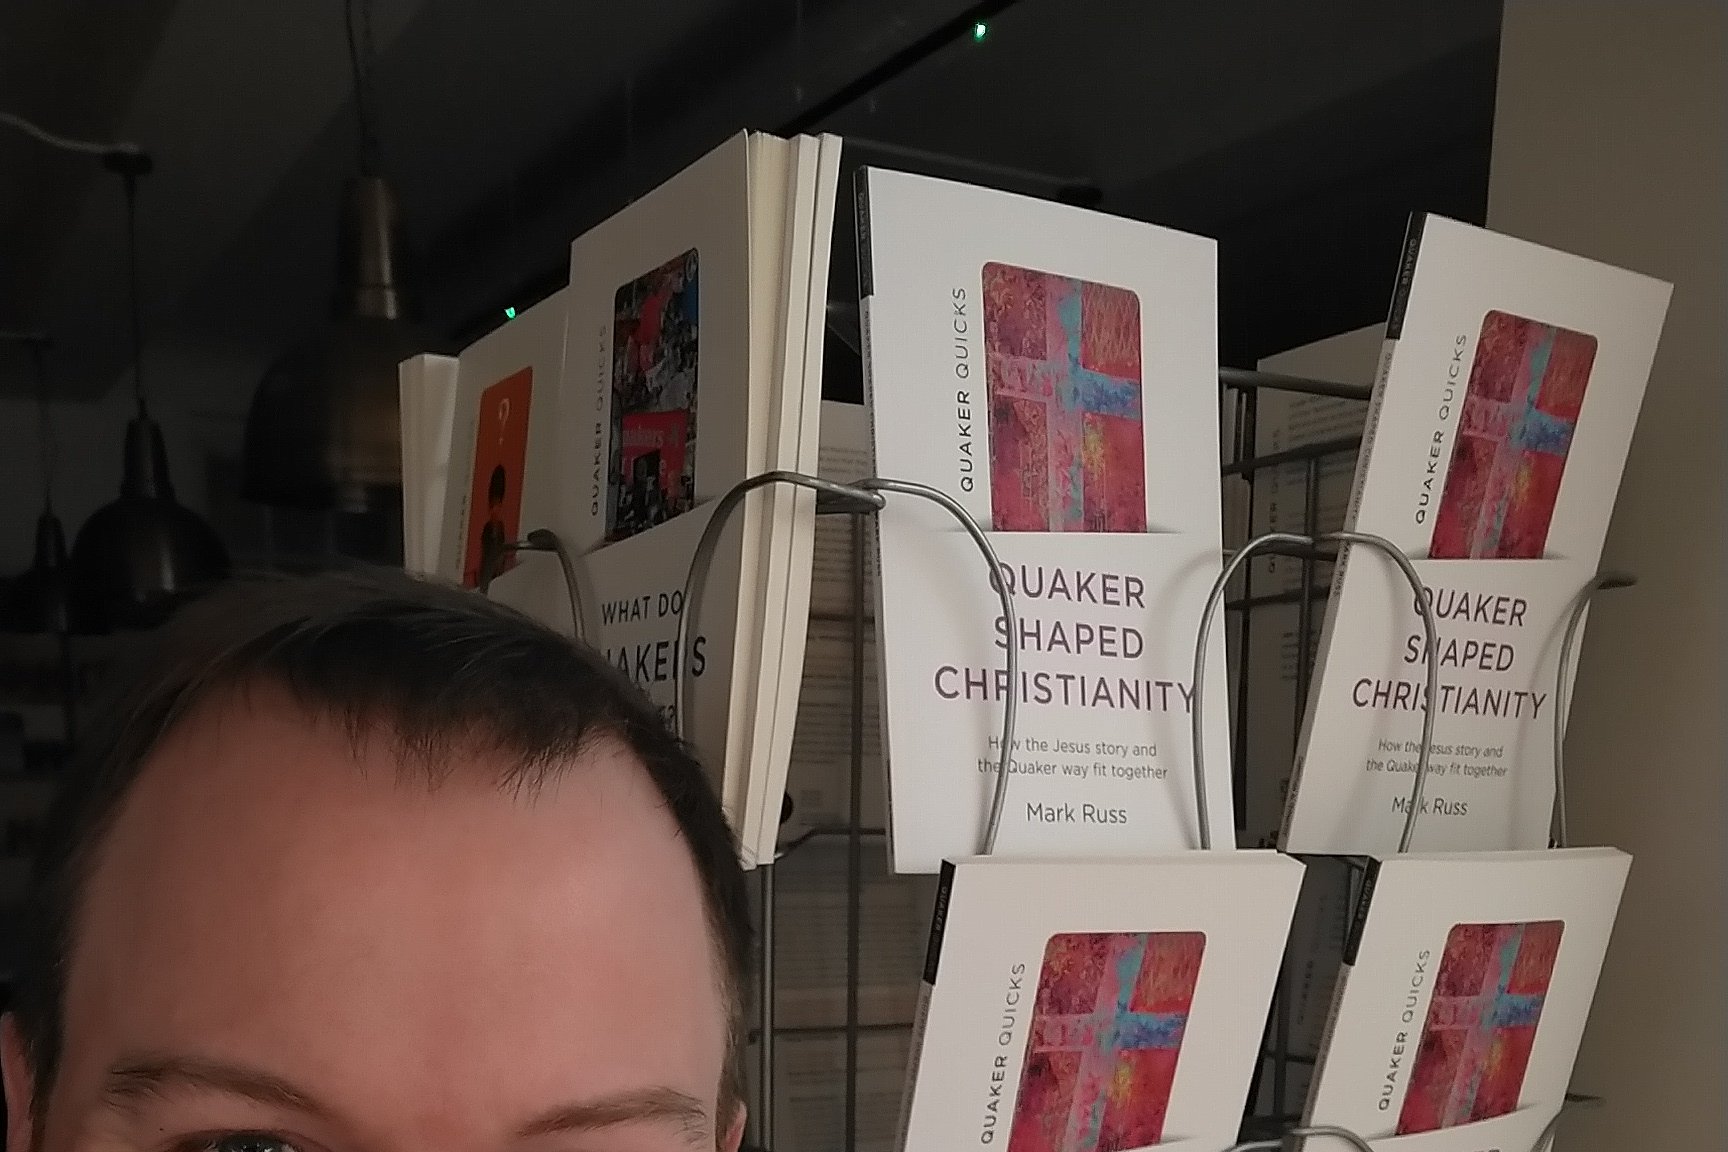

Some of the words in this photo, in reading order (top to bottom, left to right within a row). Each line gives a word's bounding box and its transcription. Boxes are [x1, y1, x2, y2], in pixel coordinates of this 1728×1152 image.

[952, 286, 971, 380] QUICKS
[957, 390, 975, 493] QUAKER
[1414, 429, 1446, 525] QUAKER
[1438, 333, 1467, 421] QUICKS
[590, 422, 603, 517] QUAKER
[988, 561, 1146, 609] QUAKER
[1412, 585, 1528, 628] QUAKER
[602, 595, 651, 627] WHAT
[658, 590, 684, 618] DO
[605, 636, 707, 683] AKES
[993, 614, 1145, 660] SHAPED
[977, 757, 1000, 774] the
[1007, 758, 1057, 777] Quaker
[1061, 762, 1088, 780] way
[1093, 762, 1108, 778] fit
[1111, 764, 1168, 781] together
[1025, 736, 1049, 753] the
[1052, 738, 1091, 755] Jesus
[1095, 740, 1129, 758] story
[1132, 741, 1158, 757] and
[1428, 743, 1453, 757] esus
[1455, 744, 1481, 760] story
[1483, 745, 1504, 759] and
[1463, 763, 1508, 779] together
[1025, 802, 1076, 824] Mark
[1082, 803, 1128, 825] Russ
[1391, 797, 1428, 815] Mak
[1432, 798, 1469, 816] Russ
[1378, 1031, 1408, 1112] QUAKER
[1402, 949, 1431, 1024] QUICKS
[981, 1054, 1009, 1146] QUAKER
[998, 962, 1026, 1047] QUICKS
